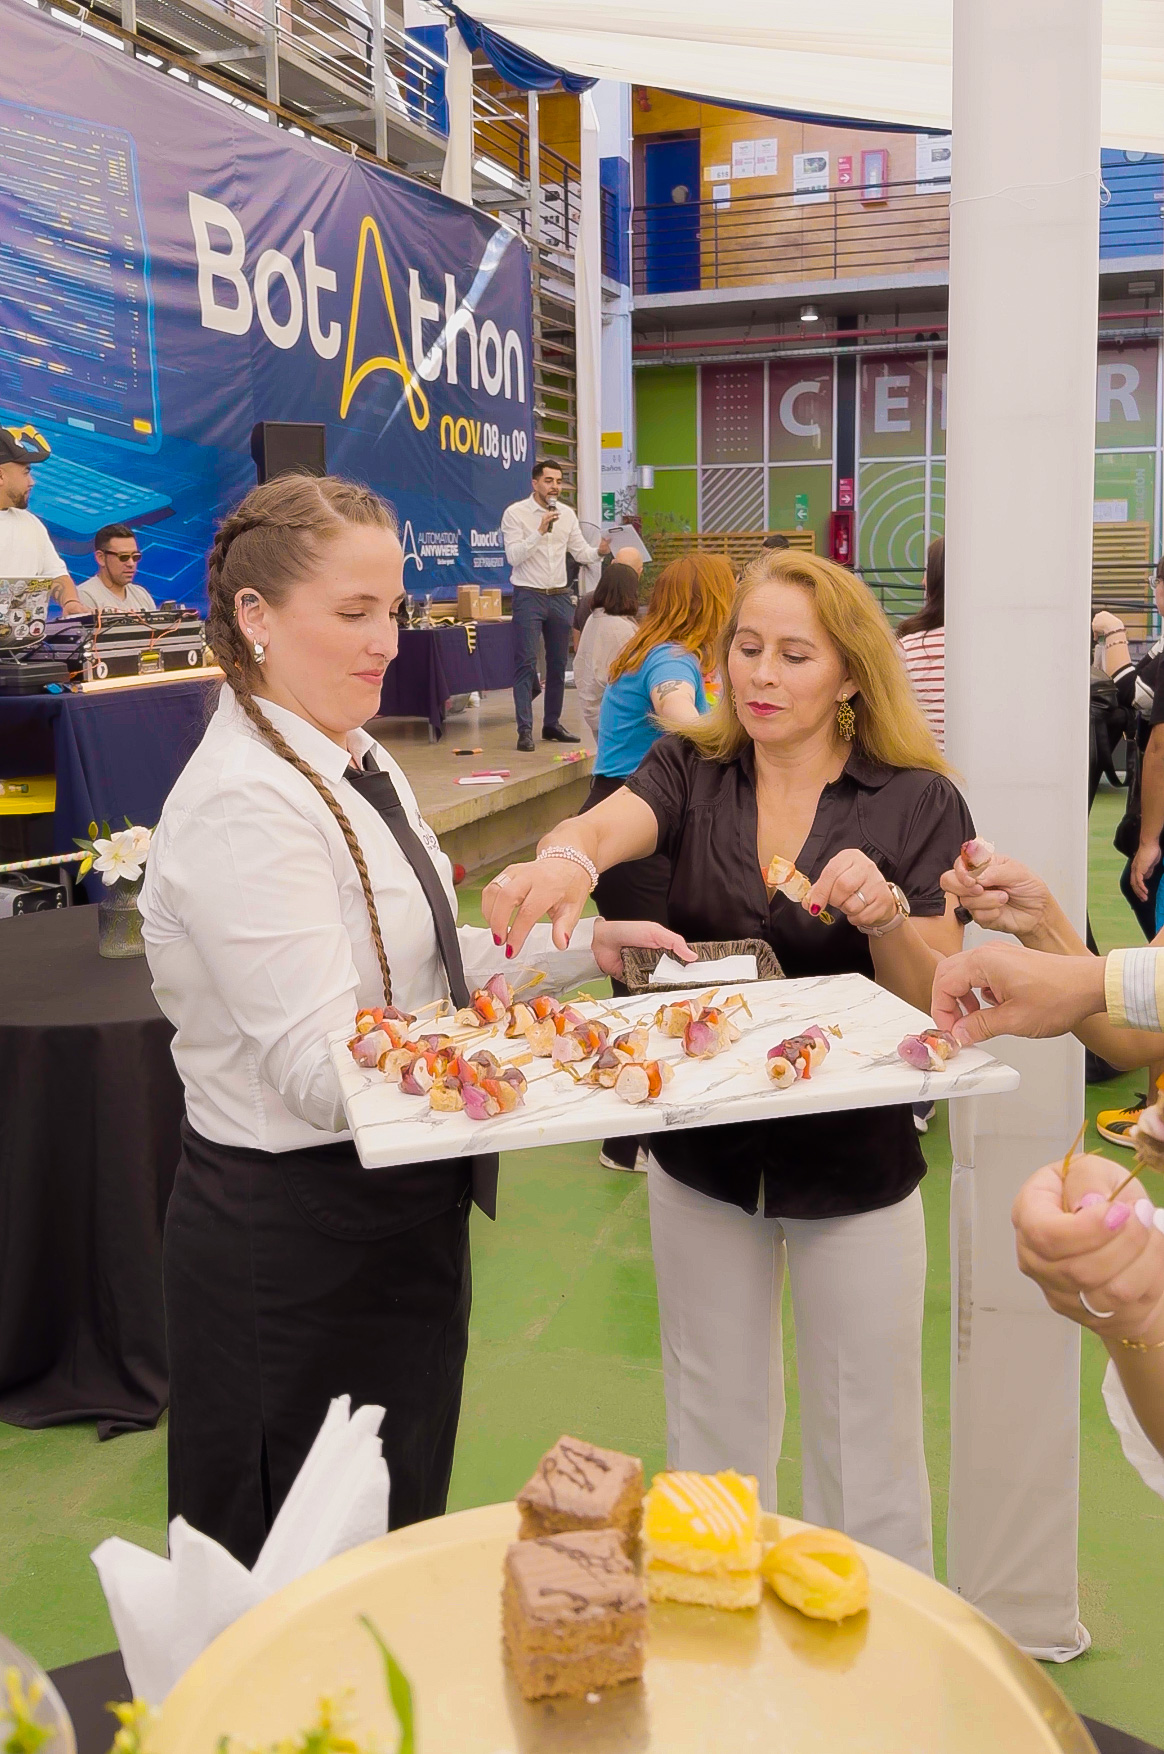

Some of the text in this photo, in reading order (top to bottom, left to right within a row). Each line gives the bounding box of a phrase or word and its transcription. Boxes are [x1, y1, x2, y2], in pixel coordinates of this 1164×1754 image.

[501, 433, 512, 470] y
[512, 429, 528, 463] 09
[470, 529, 500, 547] DuocUC
[420, 544, 460, 557] ANYWHERE
